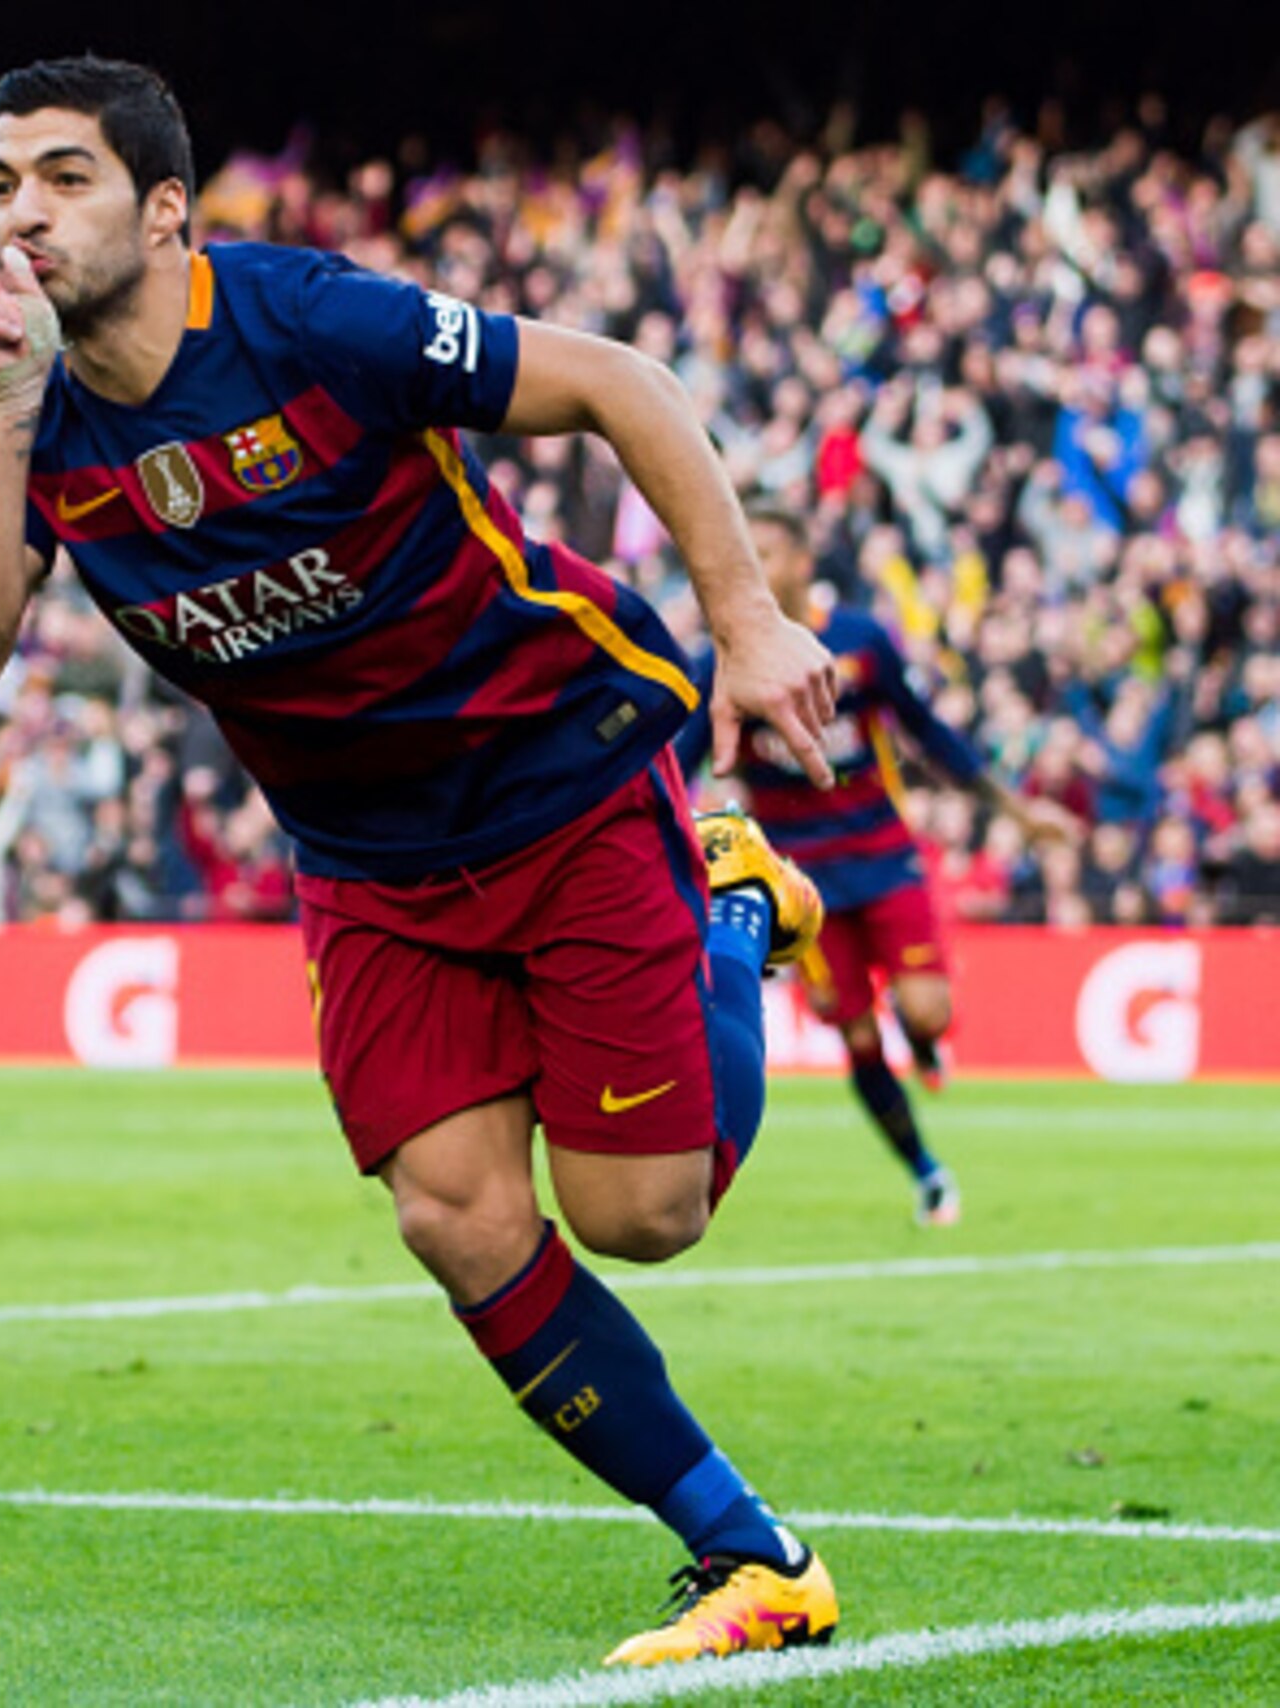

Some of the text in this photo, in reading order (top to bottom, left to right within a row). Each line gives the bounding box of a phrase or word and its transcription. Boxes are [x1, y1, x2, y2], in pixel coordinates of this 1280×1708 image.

[115, 547, 348, 649] QATAR
[194, 582, 364, 663] AIRWAYS
[65, 937, 179, 1067] G
[1076, 940, 1202, 1083] G
